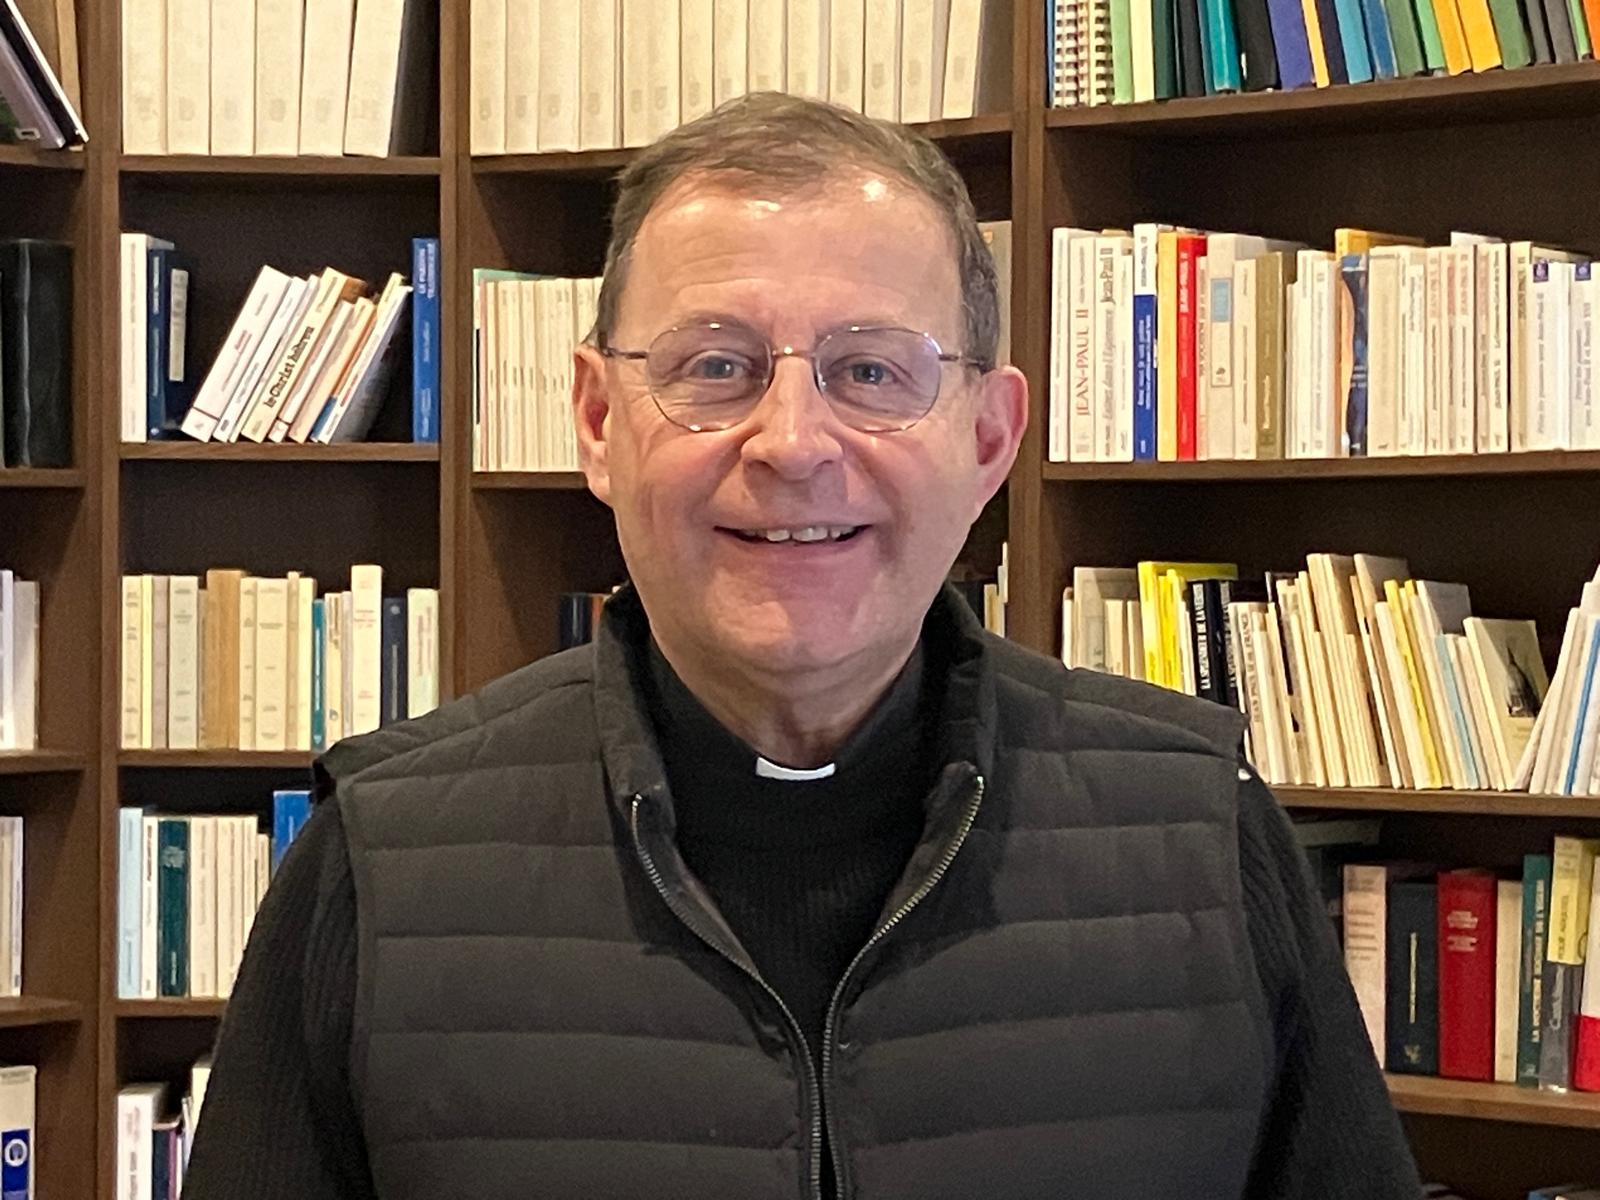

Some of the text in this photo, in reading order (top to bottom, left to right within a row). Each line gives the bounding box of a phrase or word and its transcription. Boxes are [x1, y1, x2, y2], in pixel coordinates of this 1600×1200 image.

[1100, 257, 1115, 304] Jean-Paul
[1076, 309, 1089, 318] II
[270, 361, 295, 399] Christ
[1075, 327, 1090, 416] JEAN-PAUL
